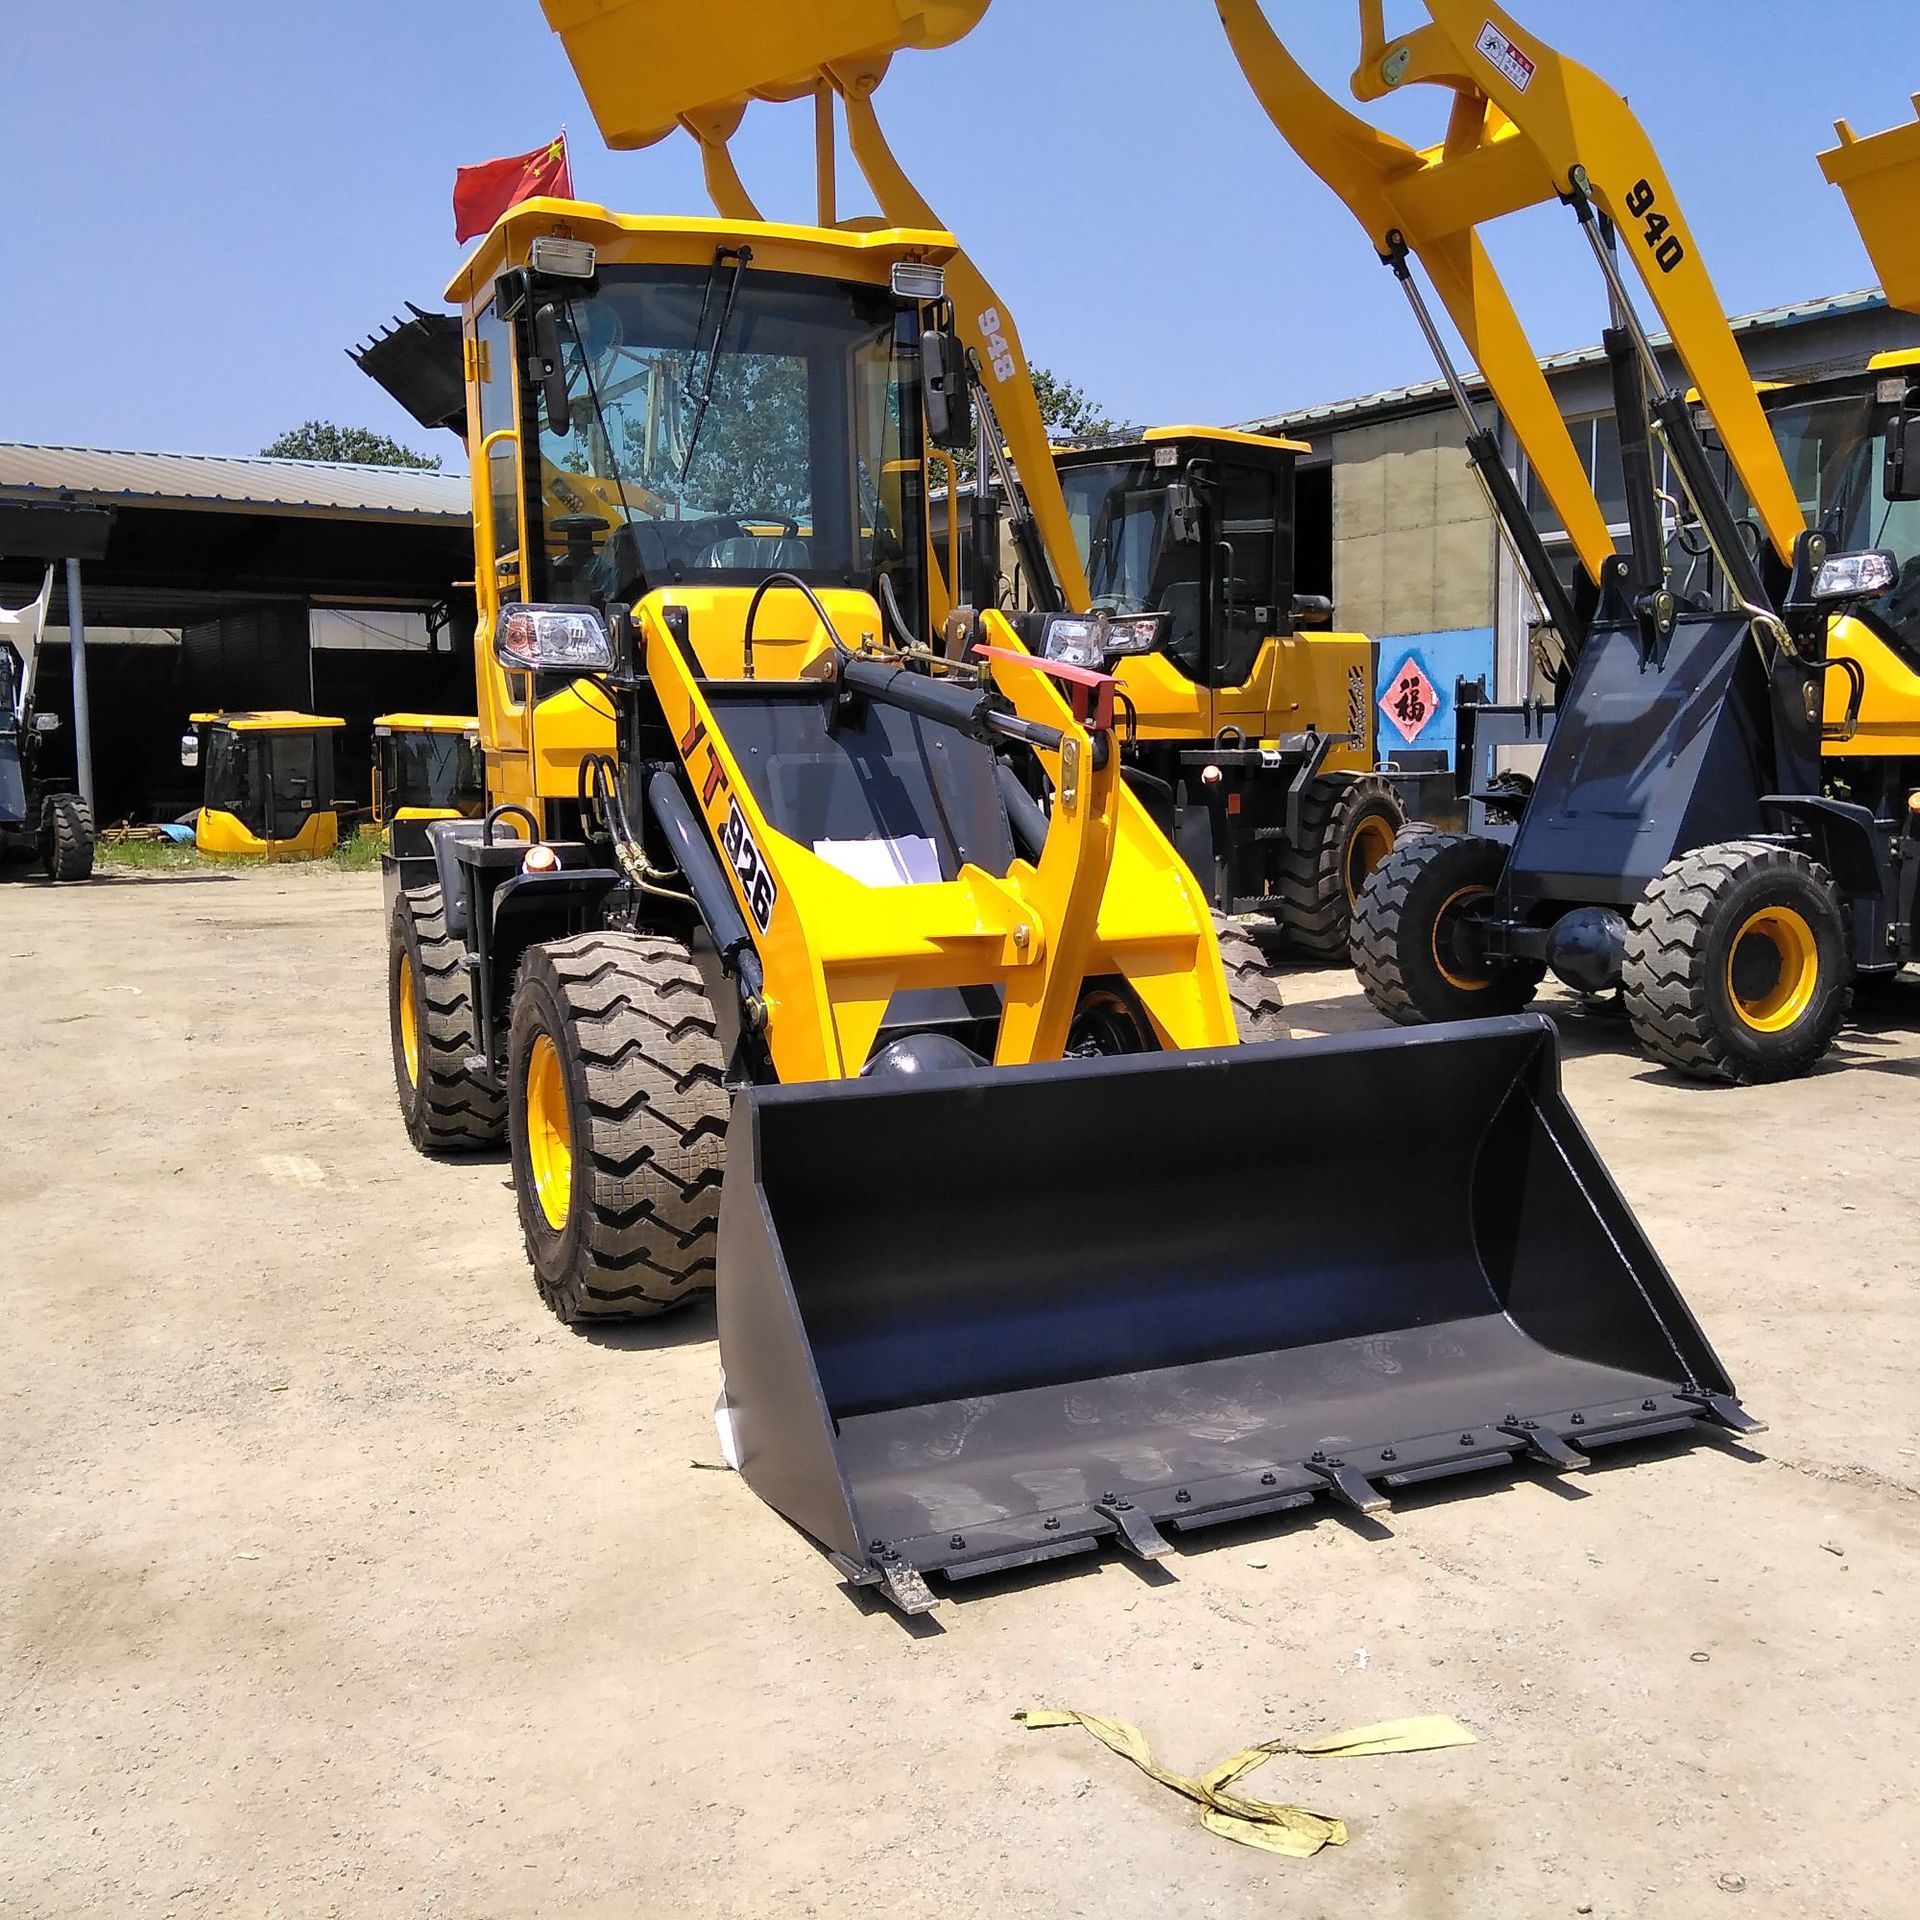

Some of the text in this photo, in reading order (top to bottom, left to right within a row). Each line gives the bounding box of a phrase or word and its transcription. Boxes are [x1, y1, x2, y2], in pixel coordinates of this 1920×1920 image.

[1625, 179, 1684, 273] 940
[978, 307, 1016, 382] 948
[1393, 676, 1426, 722] 福
[724, 805, 775, 931] 926
